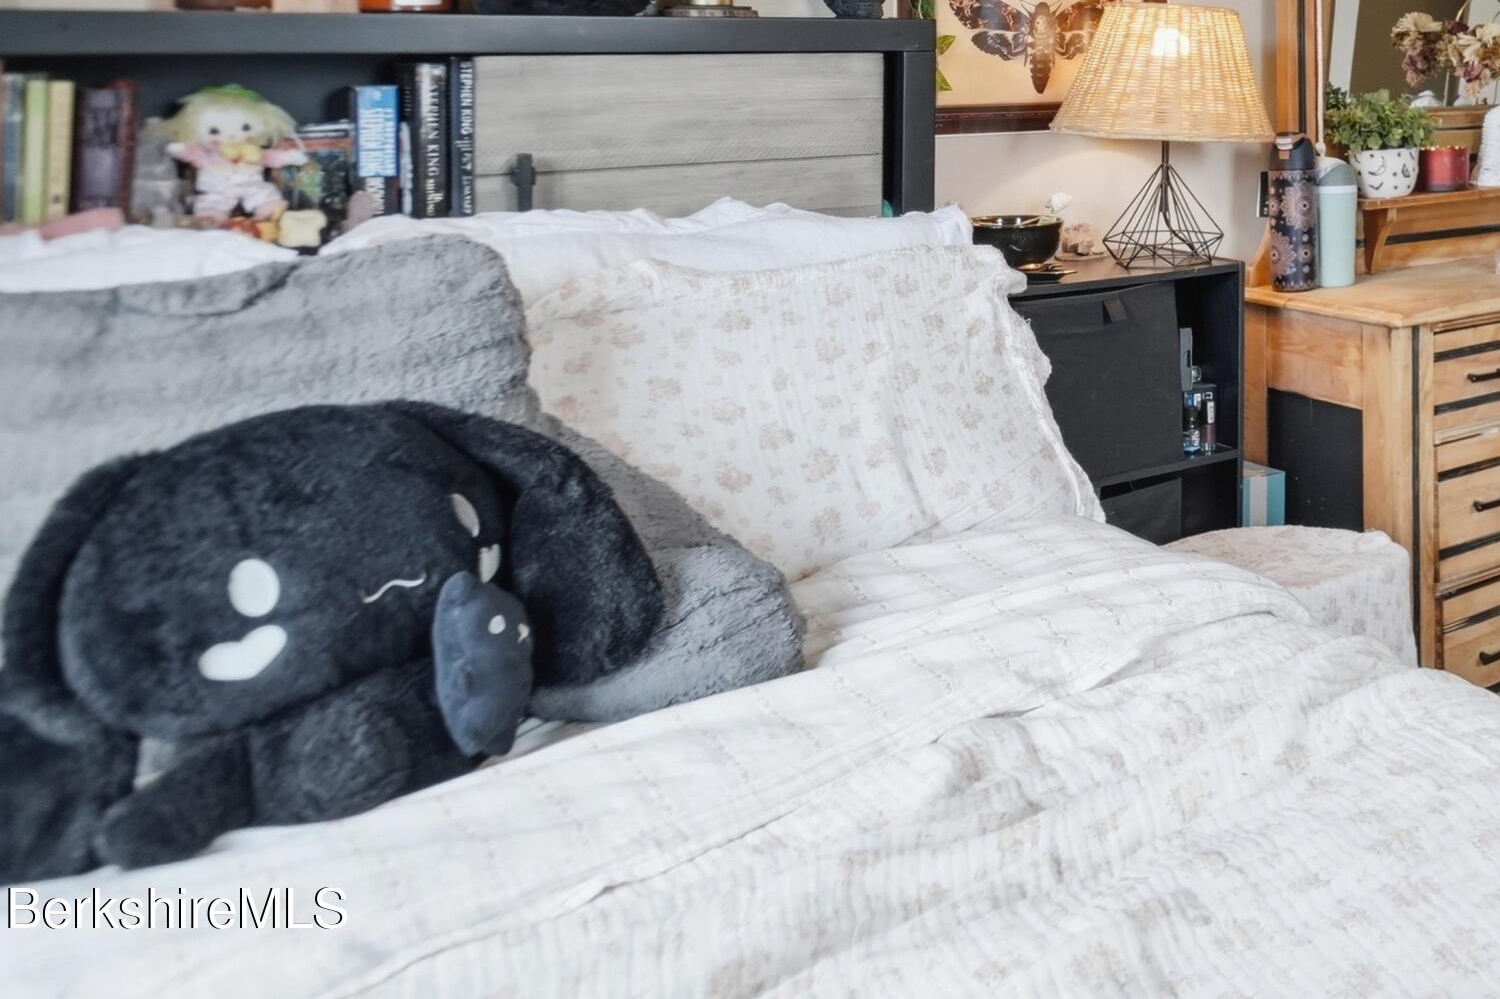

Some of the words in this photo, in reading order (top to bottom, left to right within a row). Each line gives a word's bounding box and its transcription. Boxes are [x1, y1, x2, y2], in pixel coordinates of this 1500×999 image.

[460, 61, 473, 106] STEPHEN
[460, 109, 473, 136] KING
[426, 144, 440, 177] KING
